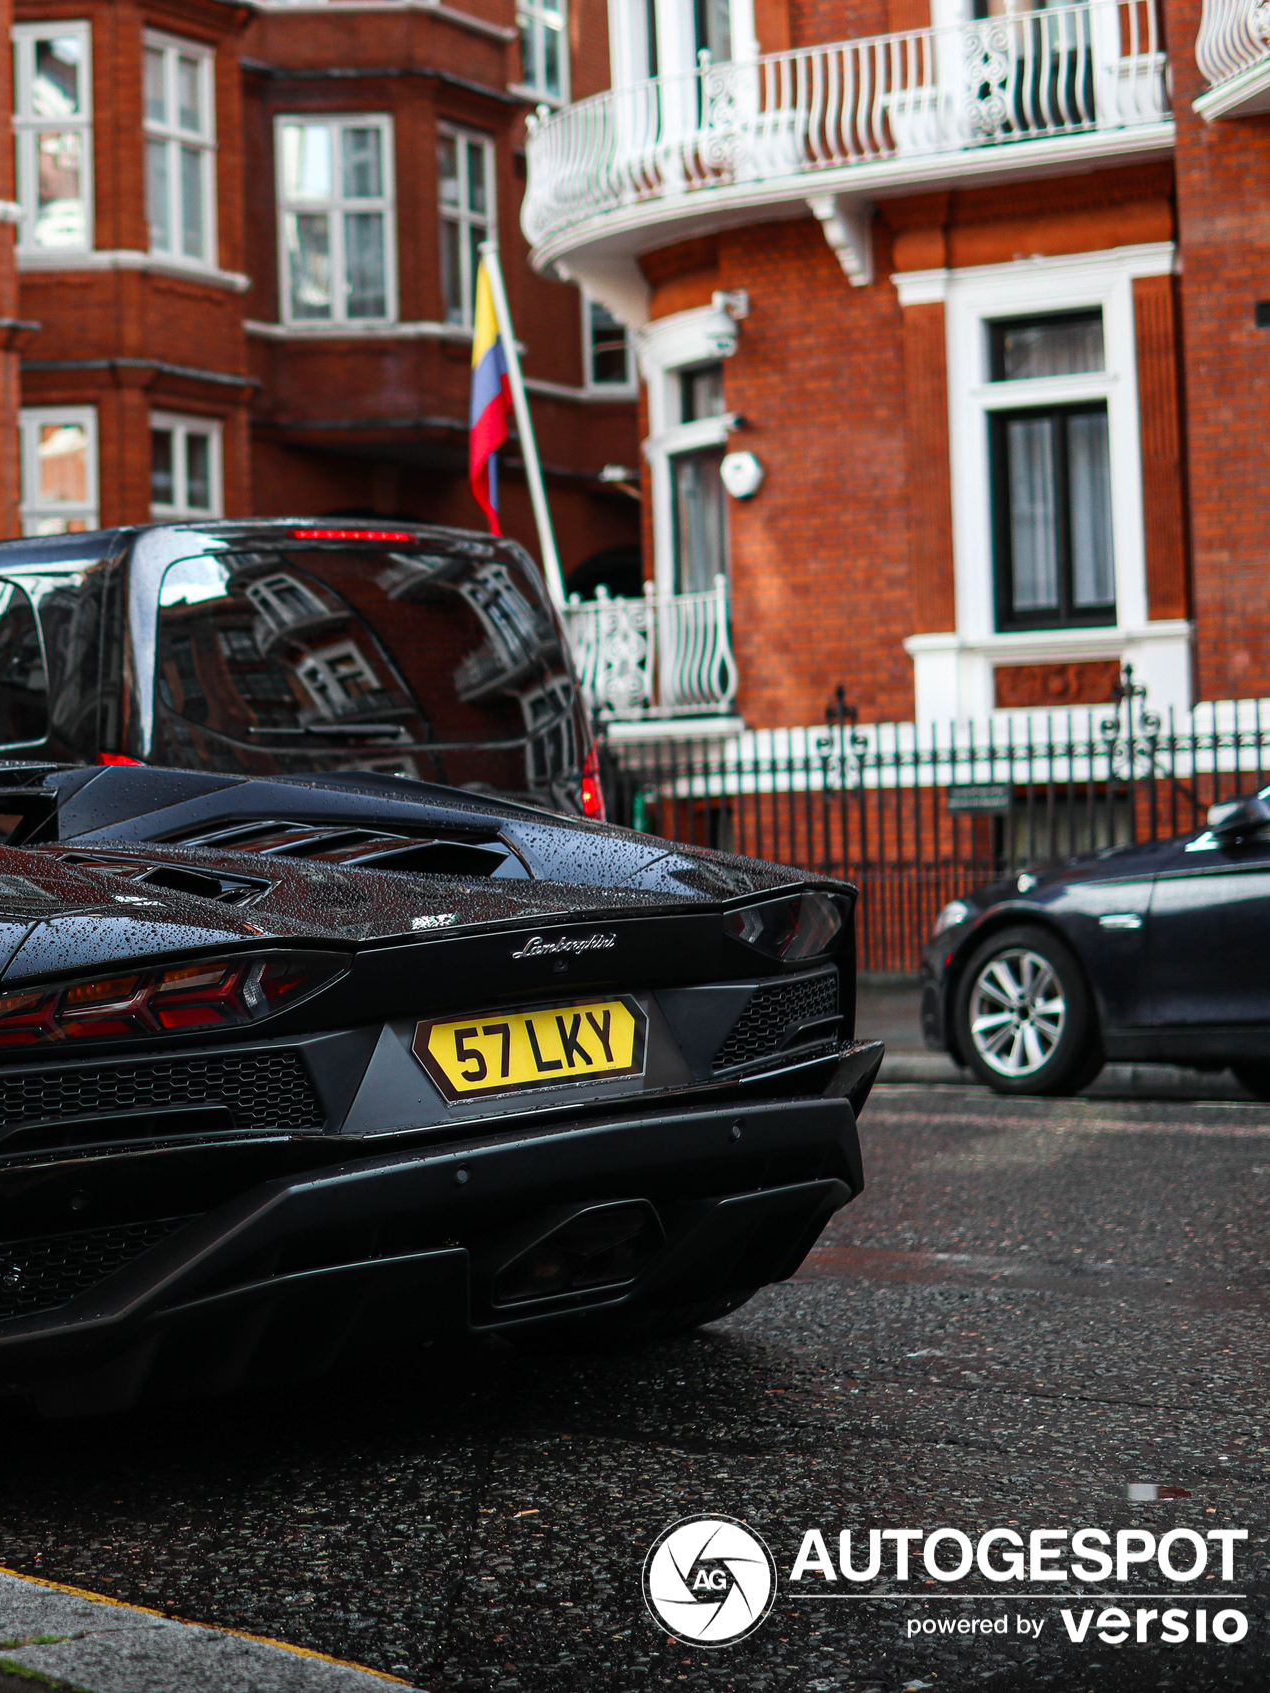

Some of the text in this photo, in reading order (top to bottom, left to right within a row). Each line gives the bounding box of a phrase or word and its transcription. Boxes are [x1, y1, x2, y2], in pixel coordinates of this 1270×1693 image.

[513, 933, 617, 959] Lamborghini
[453, 1009, 614, 1082] 57 LKY
